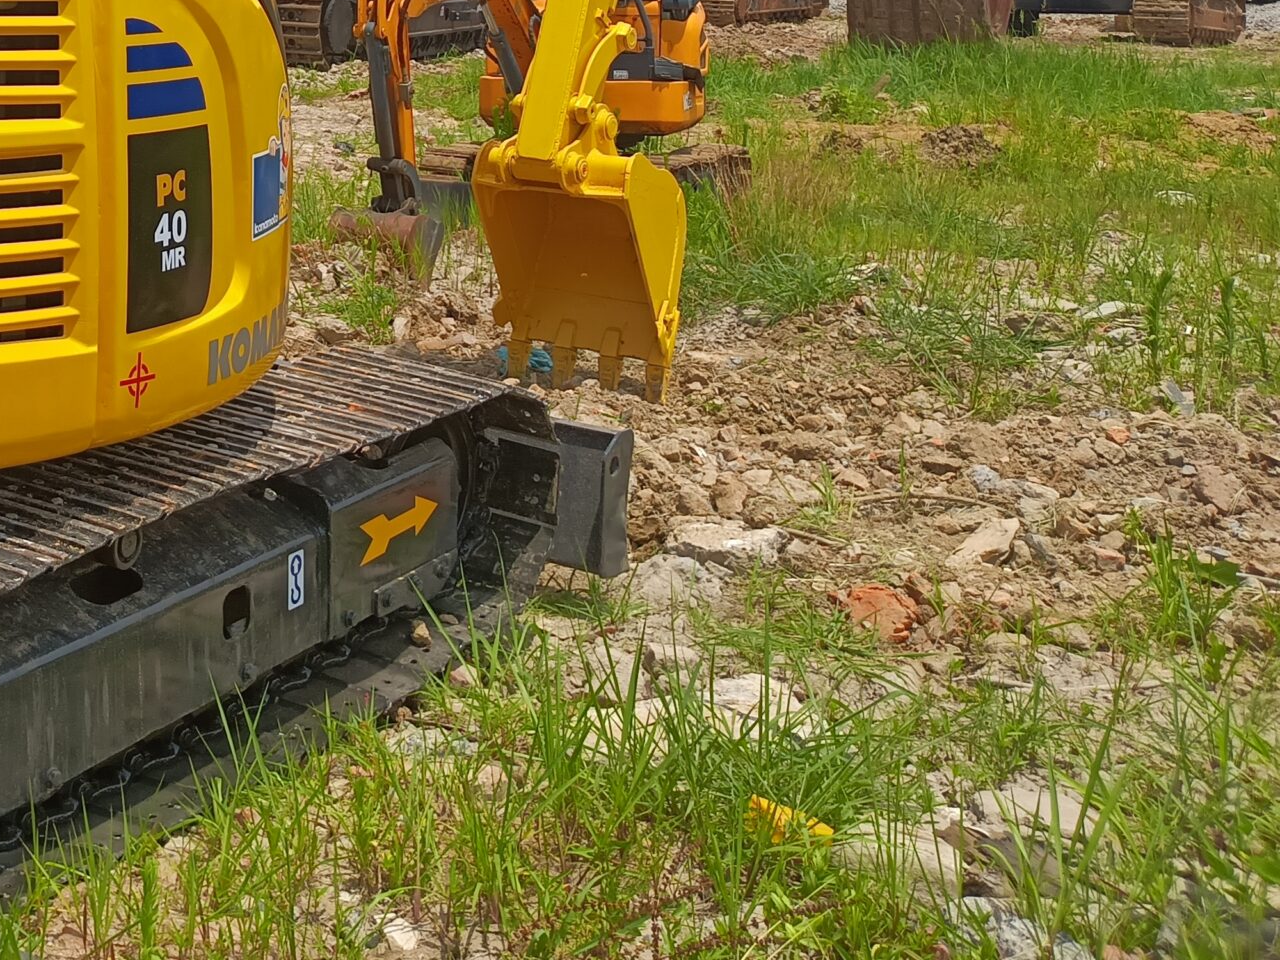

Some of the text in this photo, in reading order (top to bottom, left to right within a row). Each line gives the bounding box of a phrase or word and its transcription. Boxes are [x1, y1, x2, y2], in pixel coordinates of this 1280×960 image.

[156, 169, 186, 207] PC
[154, 209, 187, 247] 40
[161, 246, 186, 272] MR
